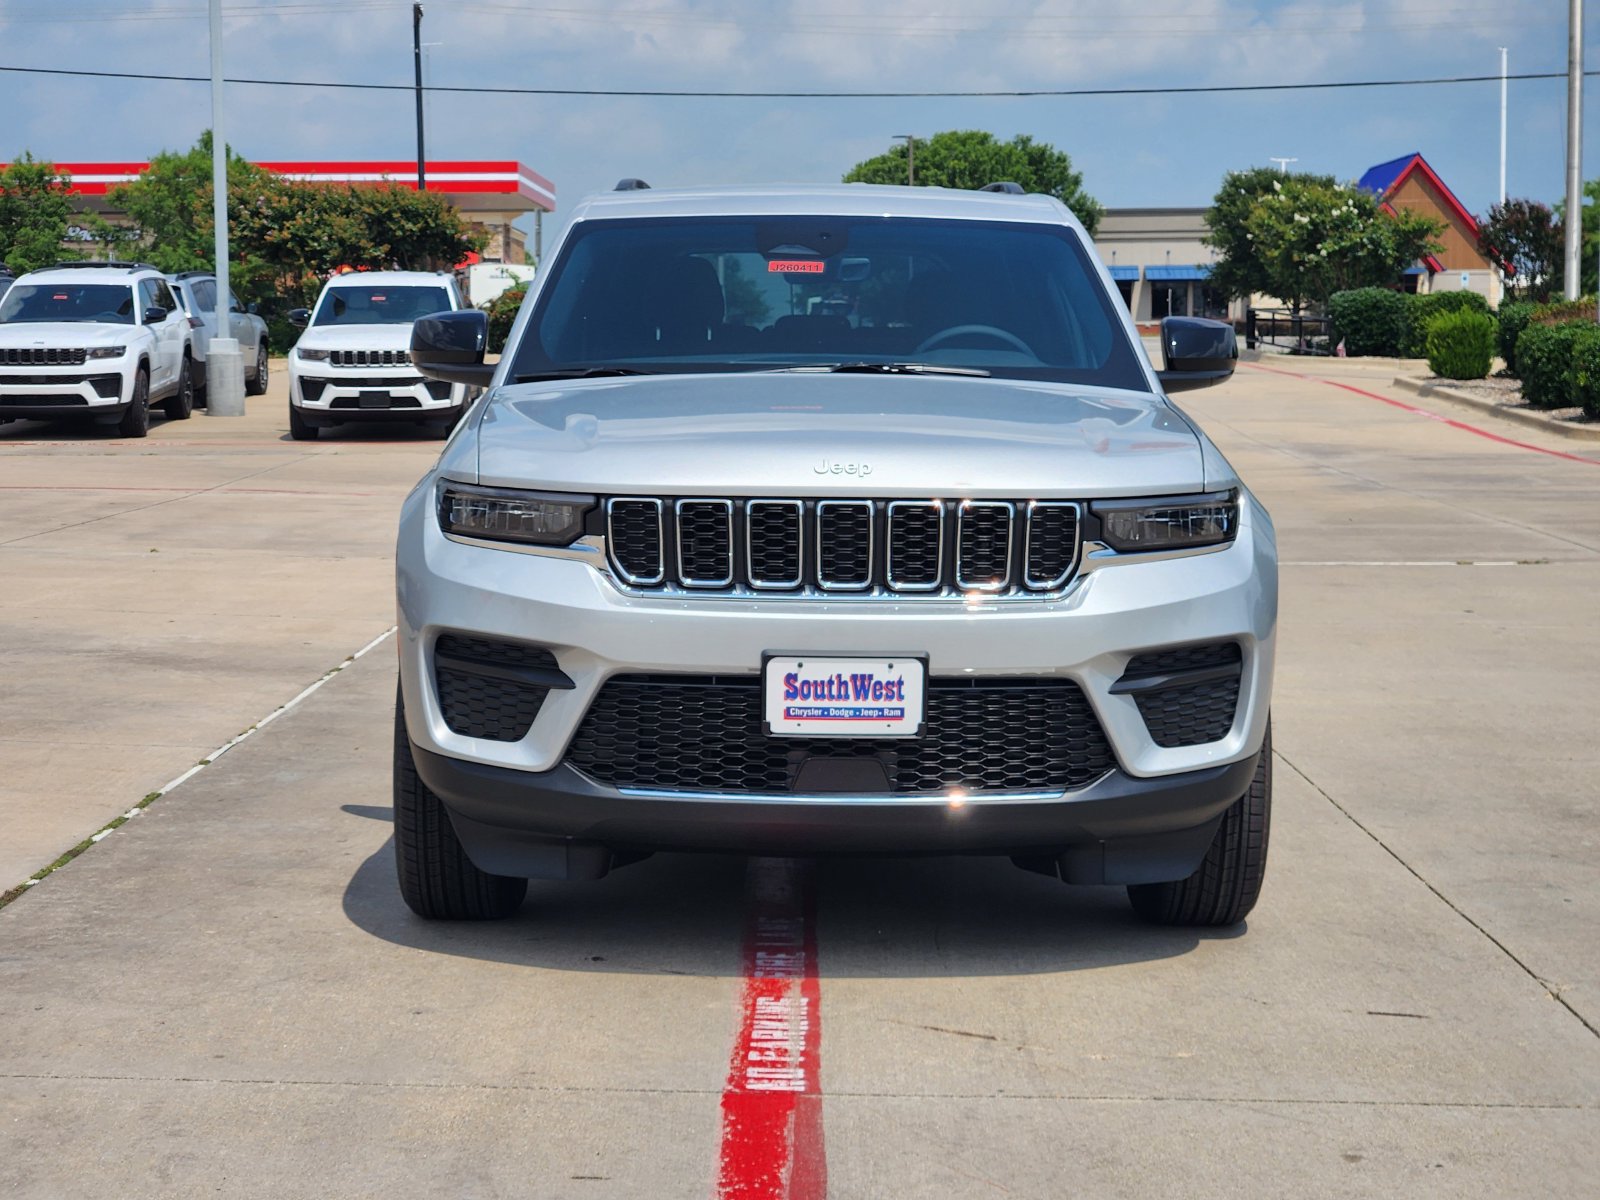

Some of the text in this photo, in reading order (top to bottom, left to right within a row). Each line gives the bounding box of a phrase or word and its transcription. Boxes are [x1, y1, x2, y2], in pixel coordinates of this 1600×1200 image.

[772, 263, 820, 272] J260411
[813, 457, 873, 478] Jeep
[789, 707, 901, 718] Chrysler Dodge Jeep Ram
[745, 1067, 806, 1092] NO
